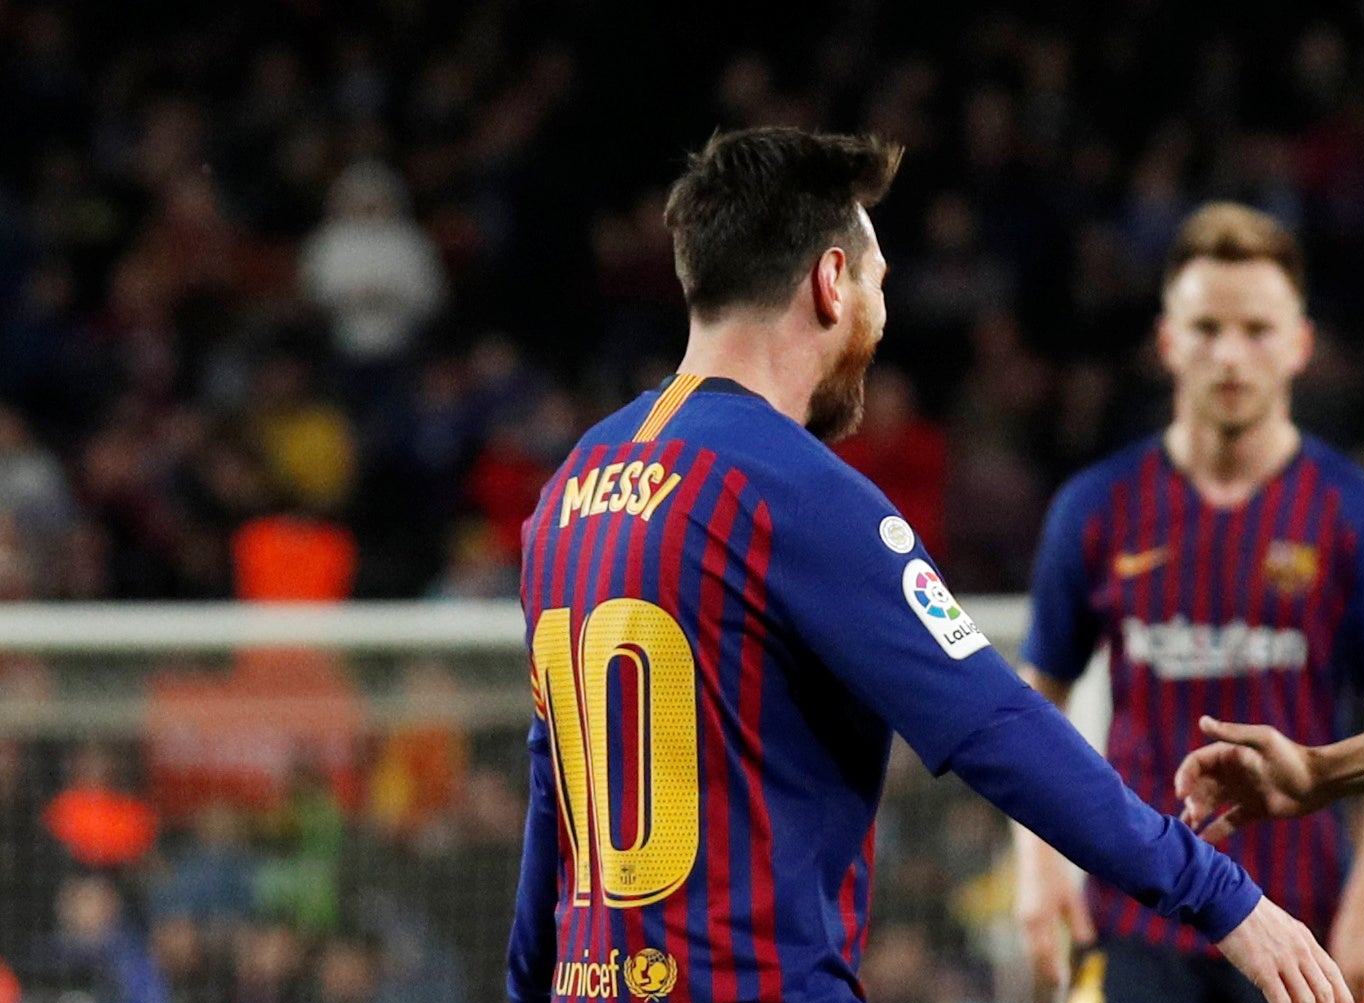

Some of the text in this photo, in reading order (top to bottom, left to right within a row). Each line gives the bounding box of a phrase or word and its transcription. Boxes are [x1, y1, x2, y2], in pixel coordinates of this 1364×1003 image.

[559, 460, 682, 528] MESSI
[532, 597, 699, 909] 10
[555, 948, 620, 999] unicef
